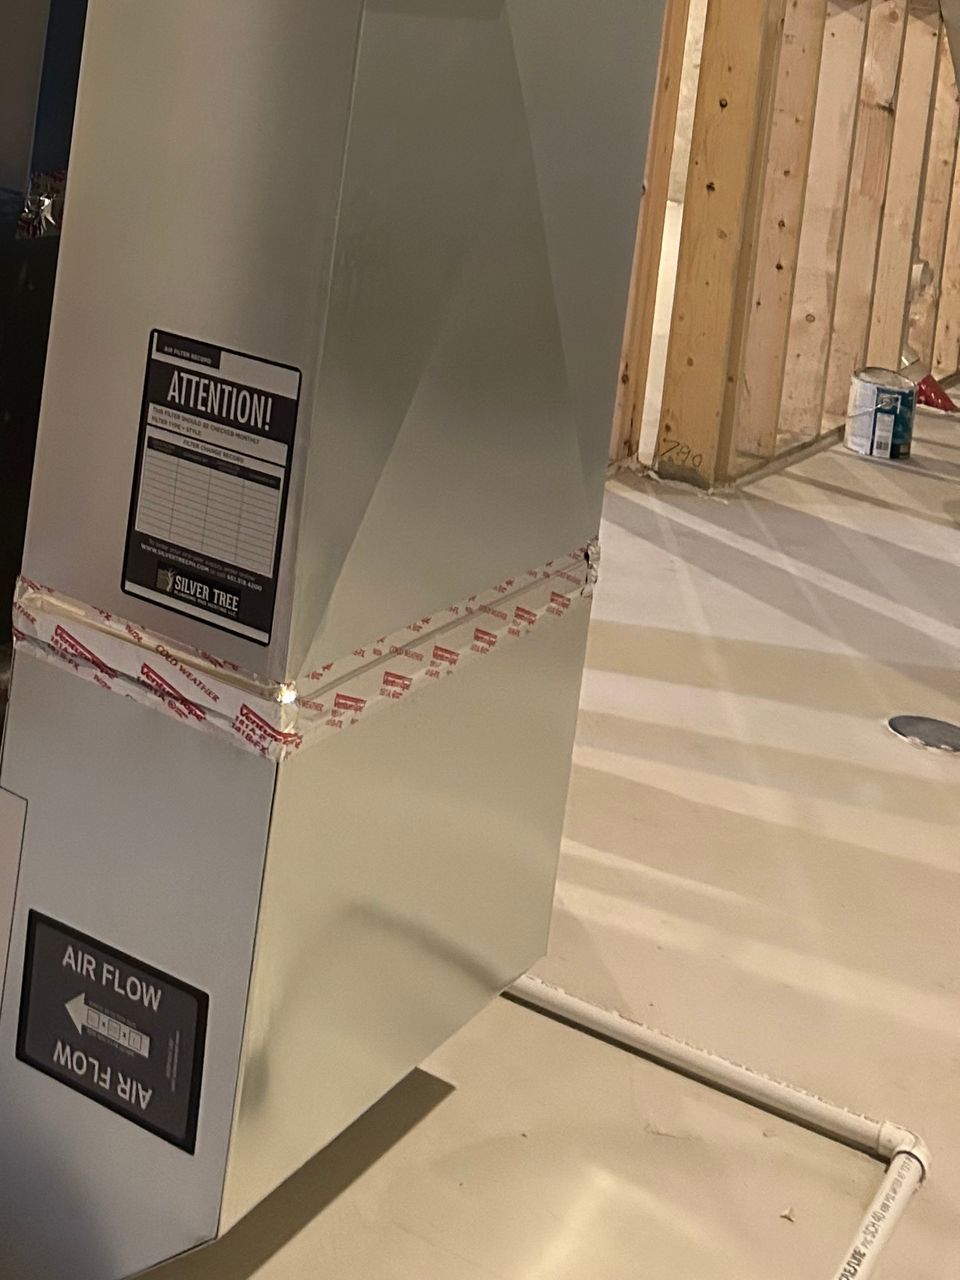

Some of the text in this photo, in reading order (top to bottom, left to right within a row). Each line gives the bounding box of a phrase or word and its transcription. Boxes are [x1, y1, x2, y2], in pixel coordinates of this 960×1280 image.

[164, 345, 212, 364] AIR FILTER RECORD
[166, 370, 273, 431] ATTENTION!
[164, 408, 181, 420] FILTER
[181, 414, 201, 427] SHOULD
[203, 420, 209, 429] BE
[210, 423, 235, 437] CHECKED
[236, 431, 260, 445] MONTHLY
[168, 421, 181, 431] TYPE
[183, 439, 199, 450] FILTER
[200, 443, 222, 457] CHANGE
[174, 575, 240, 612] SILVER TREE
[155, 644, 220, 703] COLD WEATHER
[62, 945, 162, 1013] AIR FLOW
[52, 1039, 112, 1092] FLOW
[117, 1071, 153, 1110] AIR
